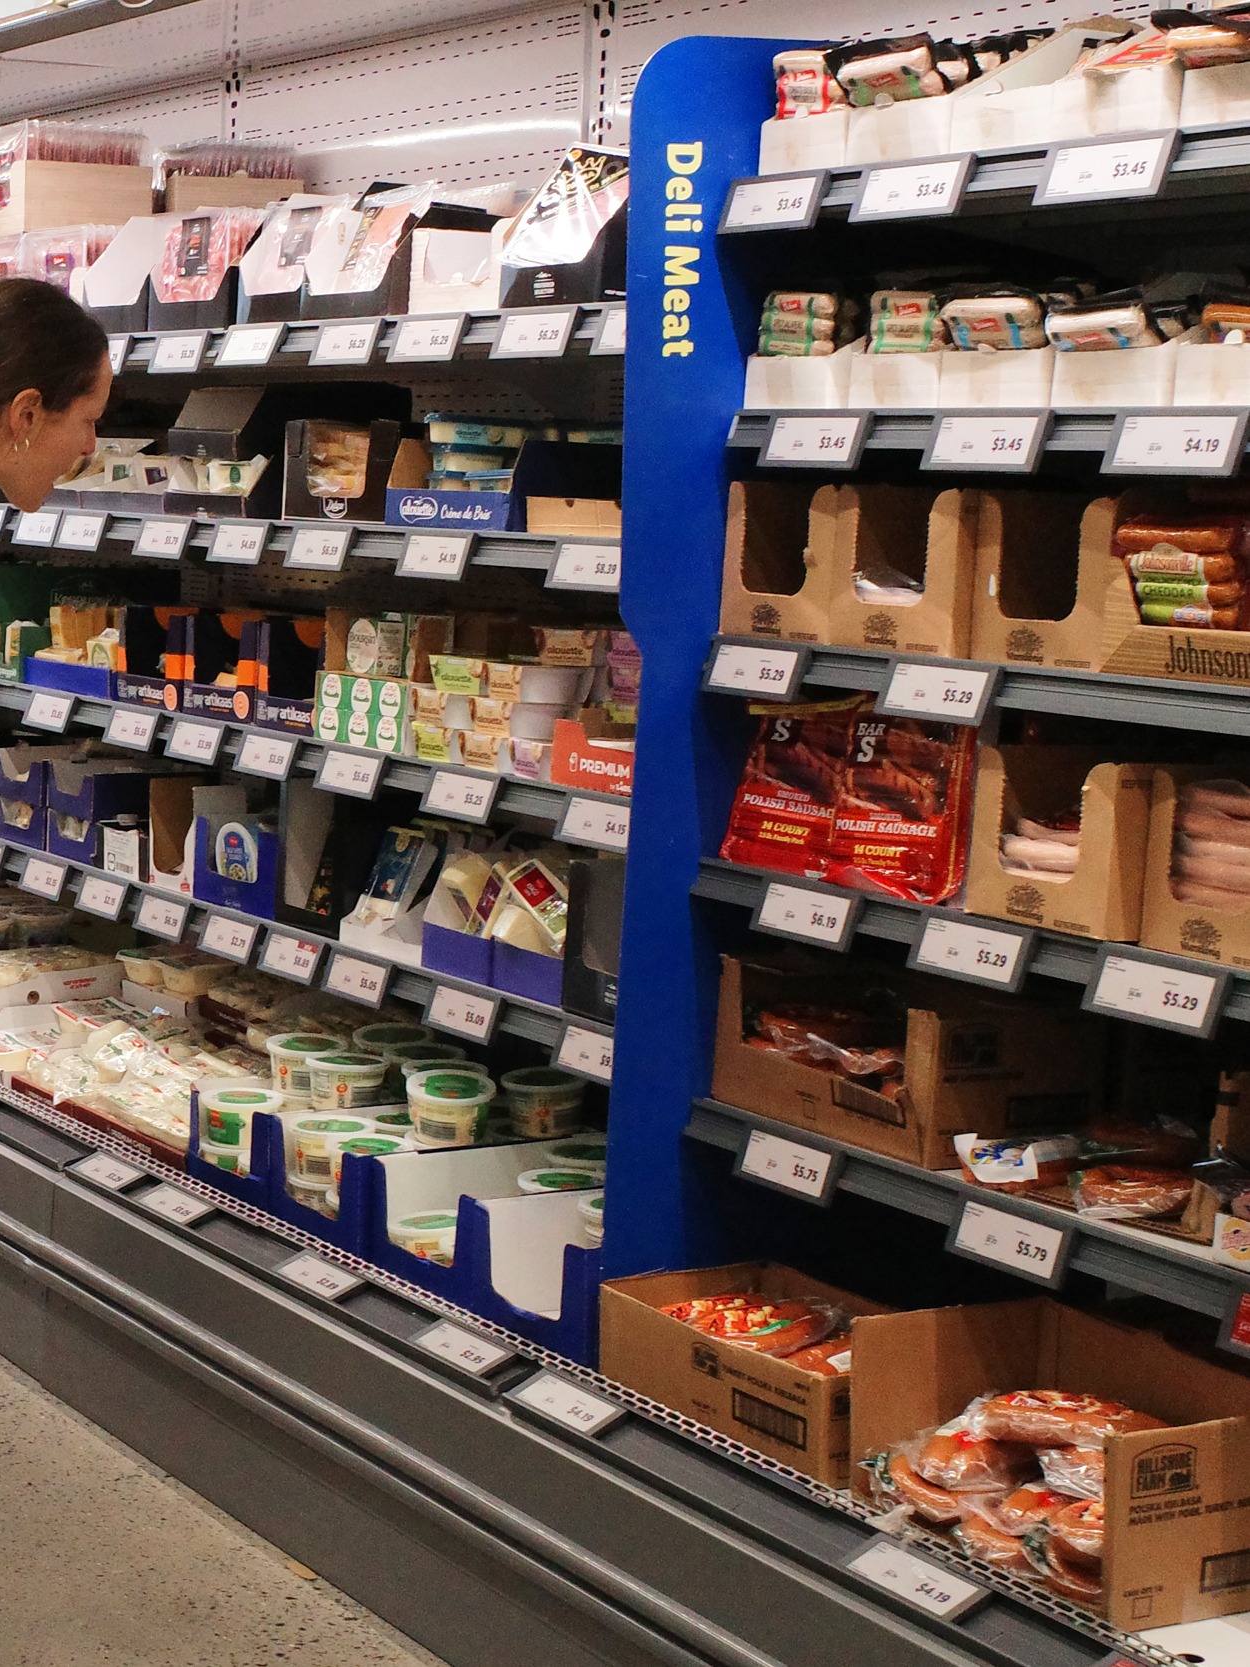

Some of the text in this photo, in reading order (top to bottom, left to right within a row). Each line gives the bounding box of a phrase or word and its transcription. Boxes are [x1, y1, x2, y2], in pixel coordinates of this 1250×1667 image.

[1112, 161, 1147, 178] $3.45
[916, 182, 946, 198] $3.45
[776, 196, 803, 212] $3.45
[662, 141, 703, 358] Deli Meat
[429, 334, 449, 346] $6.29
[538, 328, 560, 342] $6.29
[819, 436, 846, 451] $3.45
[991, 436, 1023, 452] $3.45
[1184, 436, 1220, 455] $4.19
[595, 563, 618, 576] $8.39
[1143, 584, 1194, 598] CHEDDAR
[758, 667, 785, 683] $5.29
[941, 687, 973, 705] $5.29
[770, 718, 792, 742] S
[856, 722, 887, 736] BAR
[856, 736, 877, 763] S
[579, 758, 630, 779] PREMIUM
[464, 792, 484, 807] $5.25
[743, 793, 835, 819] POLISH SAUSAG
[604, 821, 628, 836] $4.15
[761, 820, 811, 837] 14 COUNT
[836, 818, 937, 838] POLISH SAUSAGE
[854, 844, 902, 858] 14 COUNT
[810, 910, 837, 930] $6.19
[976, 947, 1008, 969] $5.29
[1162, 988, 1199, 1012] $5.29
[464, 1010, 485, 1026] $5.09
[792, 1162, 819, 1182] $5.75
[1016, 1239, 1047, 1262] $5.79
[567, 1406, 594, 1423] $4.19
[914, 1581, 952, 1604] $4.19
